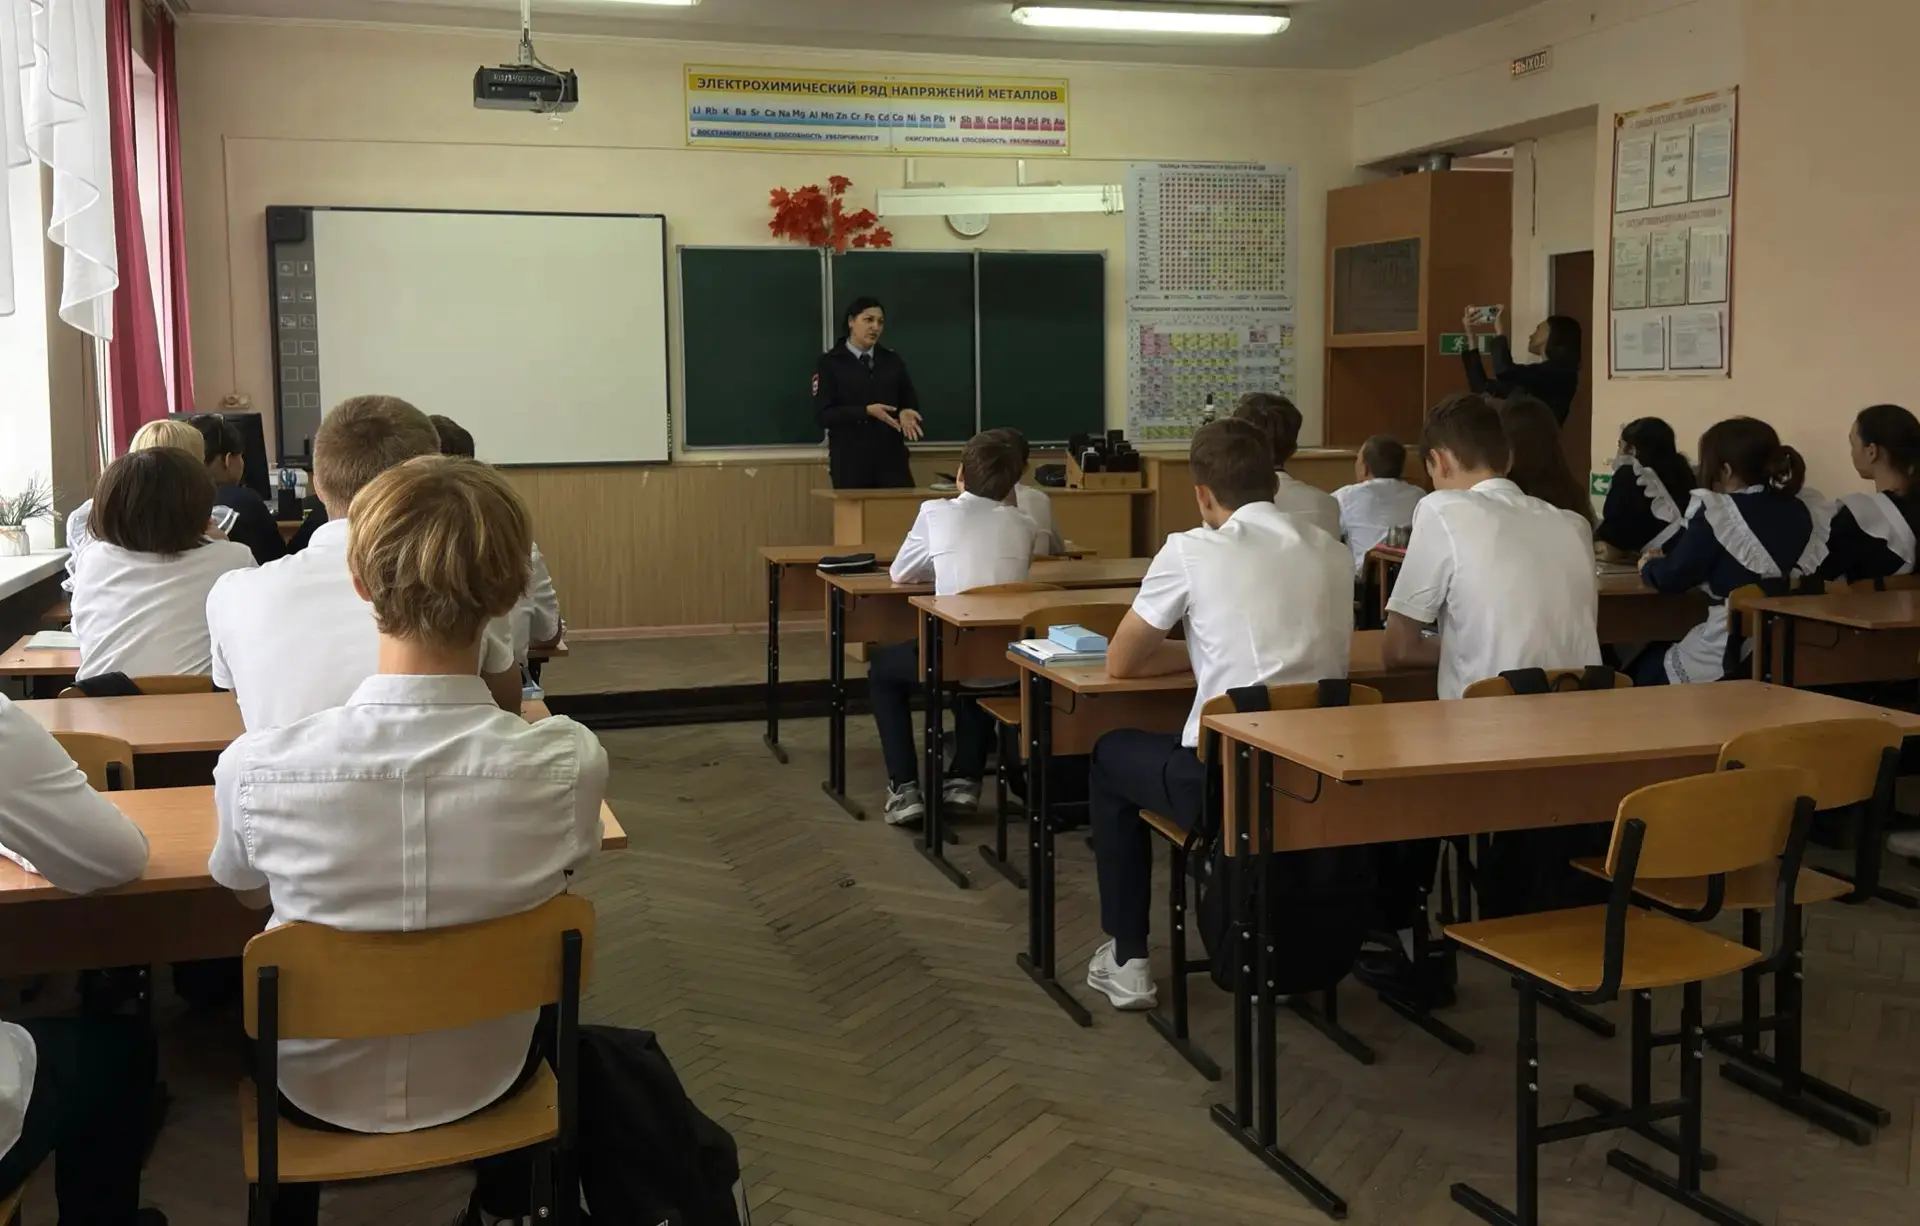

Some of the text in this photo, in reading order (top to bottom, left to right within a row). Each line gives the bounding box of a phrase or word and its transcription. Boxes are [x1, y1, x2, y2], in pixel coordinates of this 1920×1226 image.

[1515, 53, 1546, 74] ВЫХОД
[697, 77, 1058, 101] ЭЛЕКТРОХИМИЧЕСКИЙ РЯД НАПРЯЖЕНИЙ МЕТАЛЛОВ
[705, 107, 718, 115] Rb
[735, 108, 747, 116] Ba
[751, 109, 761, 117] Sr
[765, 109, 776, 117] Ca
[779, 110, 791, 118] Na
[793, 110, 806, 119] Mg
[809, 111, 819, 119] Al
[836, 112, 848, 120] Zn
[865, 113, 875, 121] Fe
[878, 113, 890, 122] Cd
[892, 114, 904, 122] Co
[907, 114, 917, 122] Ni
[933, 114, 945, 123] Pb
[949, 115, 956, 123] H
[961, 115, 972, 123] Sb
[987, 116, 998, 124] Cu
[1000, 116, 1012, 125] Hg
[1014, 116, 1025, 125] Ag
[1027, 116, 1038, 125] Pd
[1041, 117, 1051, 125] Pt
[1054, 117, 1065, 125] Au
[696, 129, 772, 138] ВОССТАНОВИТЕЛЬНАЯ
[774, 131, 822, 139] СПОСОБНОСТЬ
